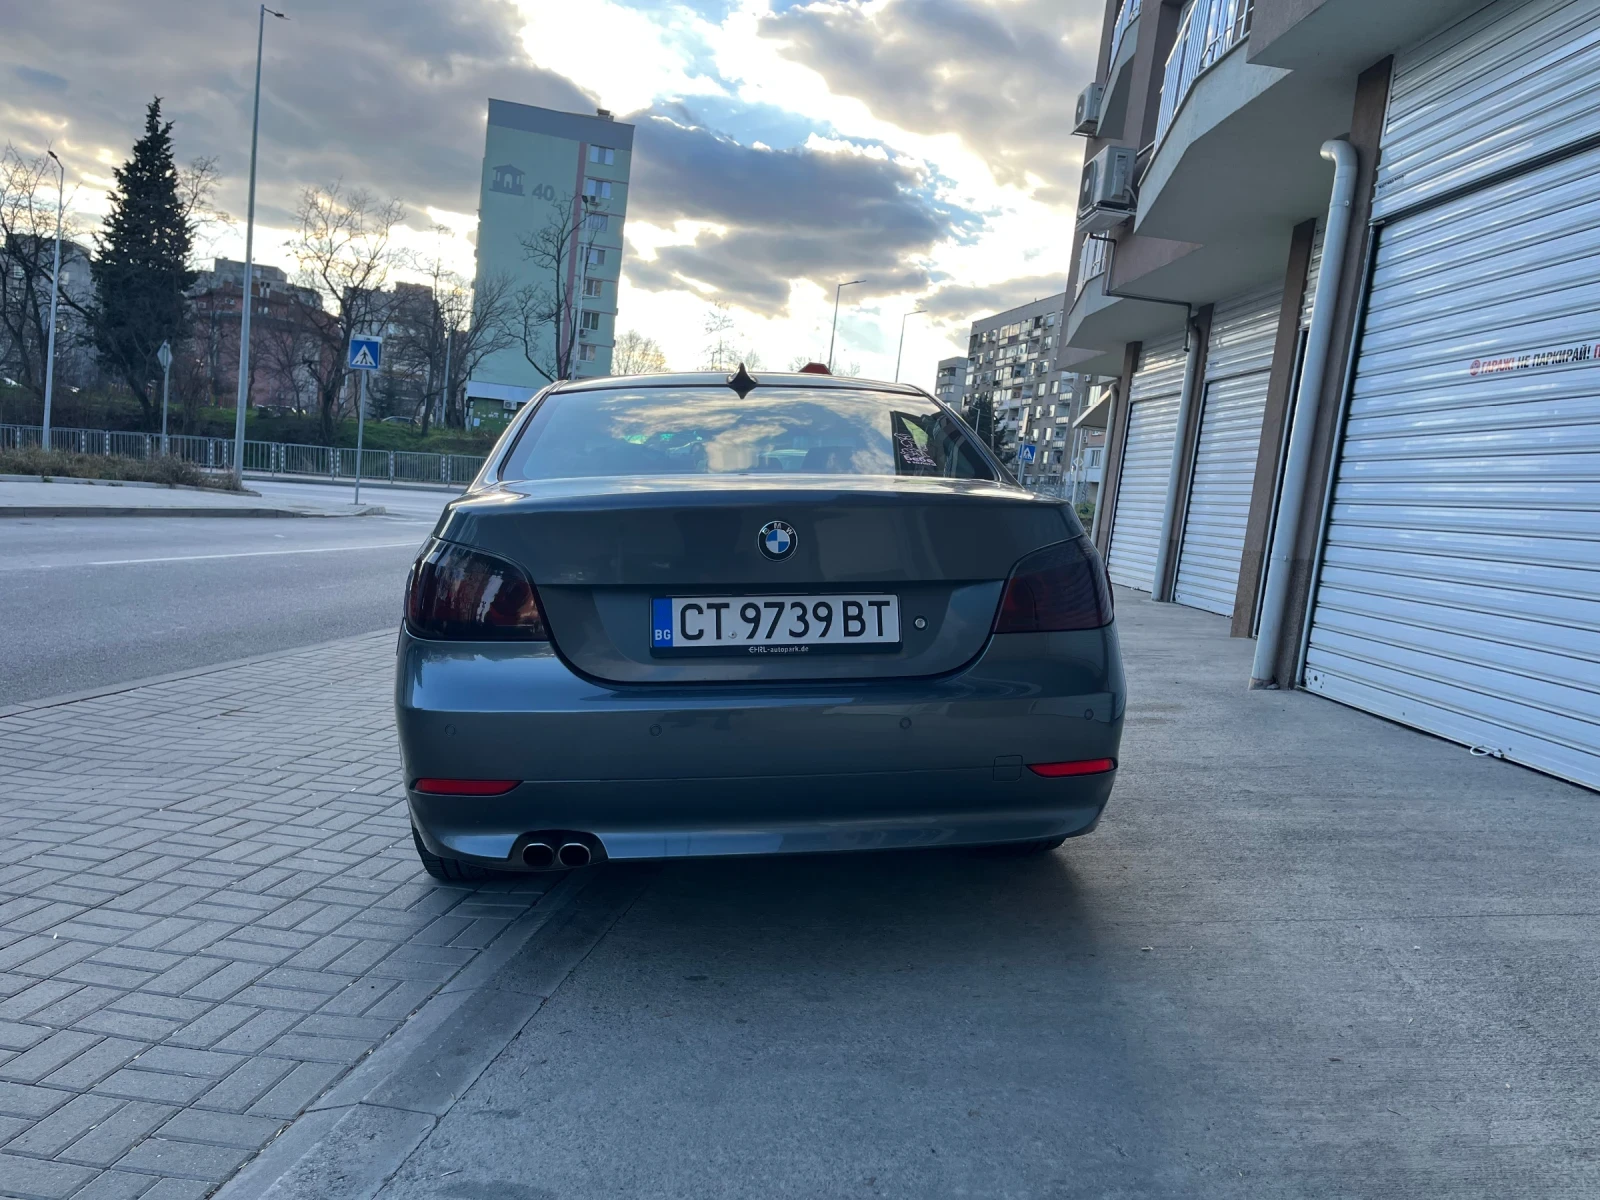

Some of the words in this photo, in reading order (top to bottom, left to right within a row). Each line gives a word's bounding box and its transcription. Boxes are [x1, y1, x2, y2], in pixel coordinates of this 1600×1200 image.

[532, 183, 555, 202] 40
[1517, 355, 1531, 369] НЕ
[1532, 344, 1592, 367] ПАРКИРАЙ!
[762, 522, 794, 535] BMW
[680, 602, 730, 641] CT
[740, 601, 833, 640] 9739
[842, 600, 890, 638] BT
[655, 629, 671, 641] BG
